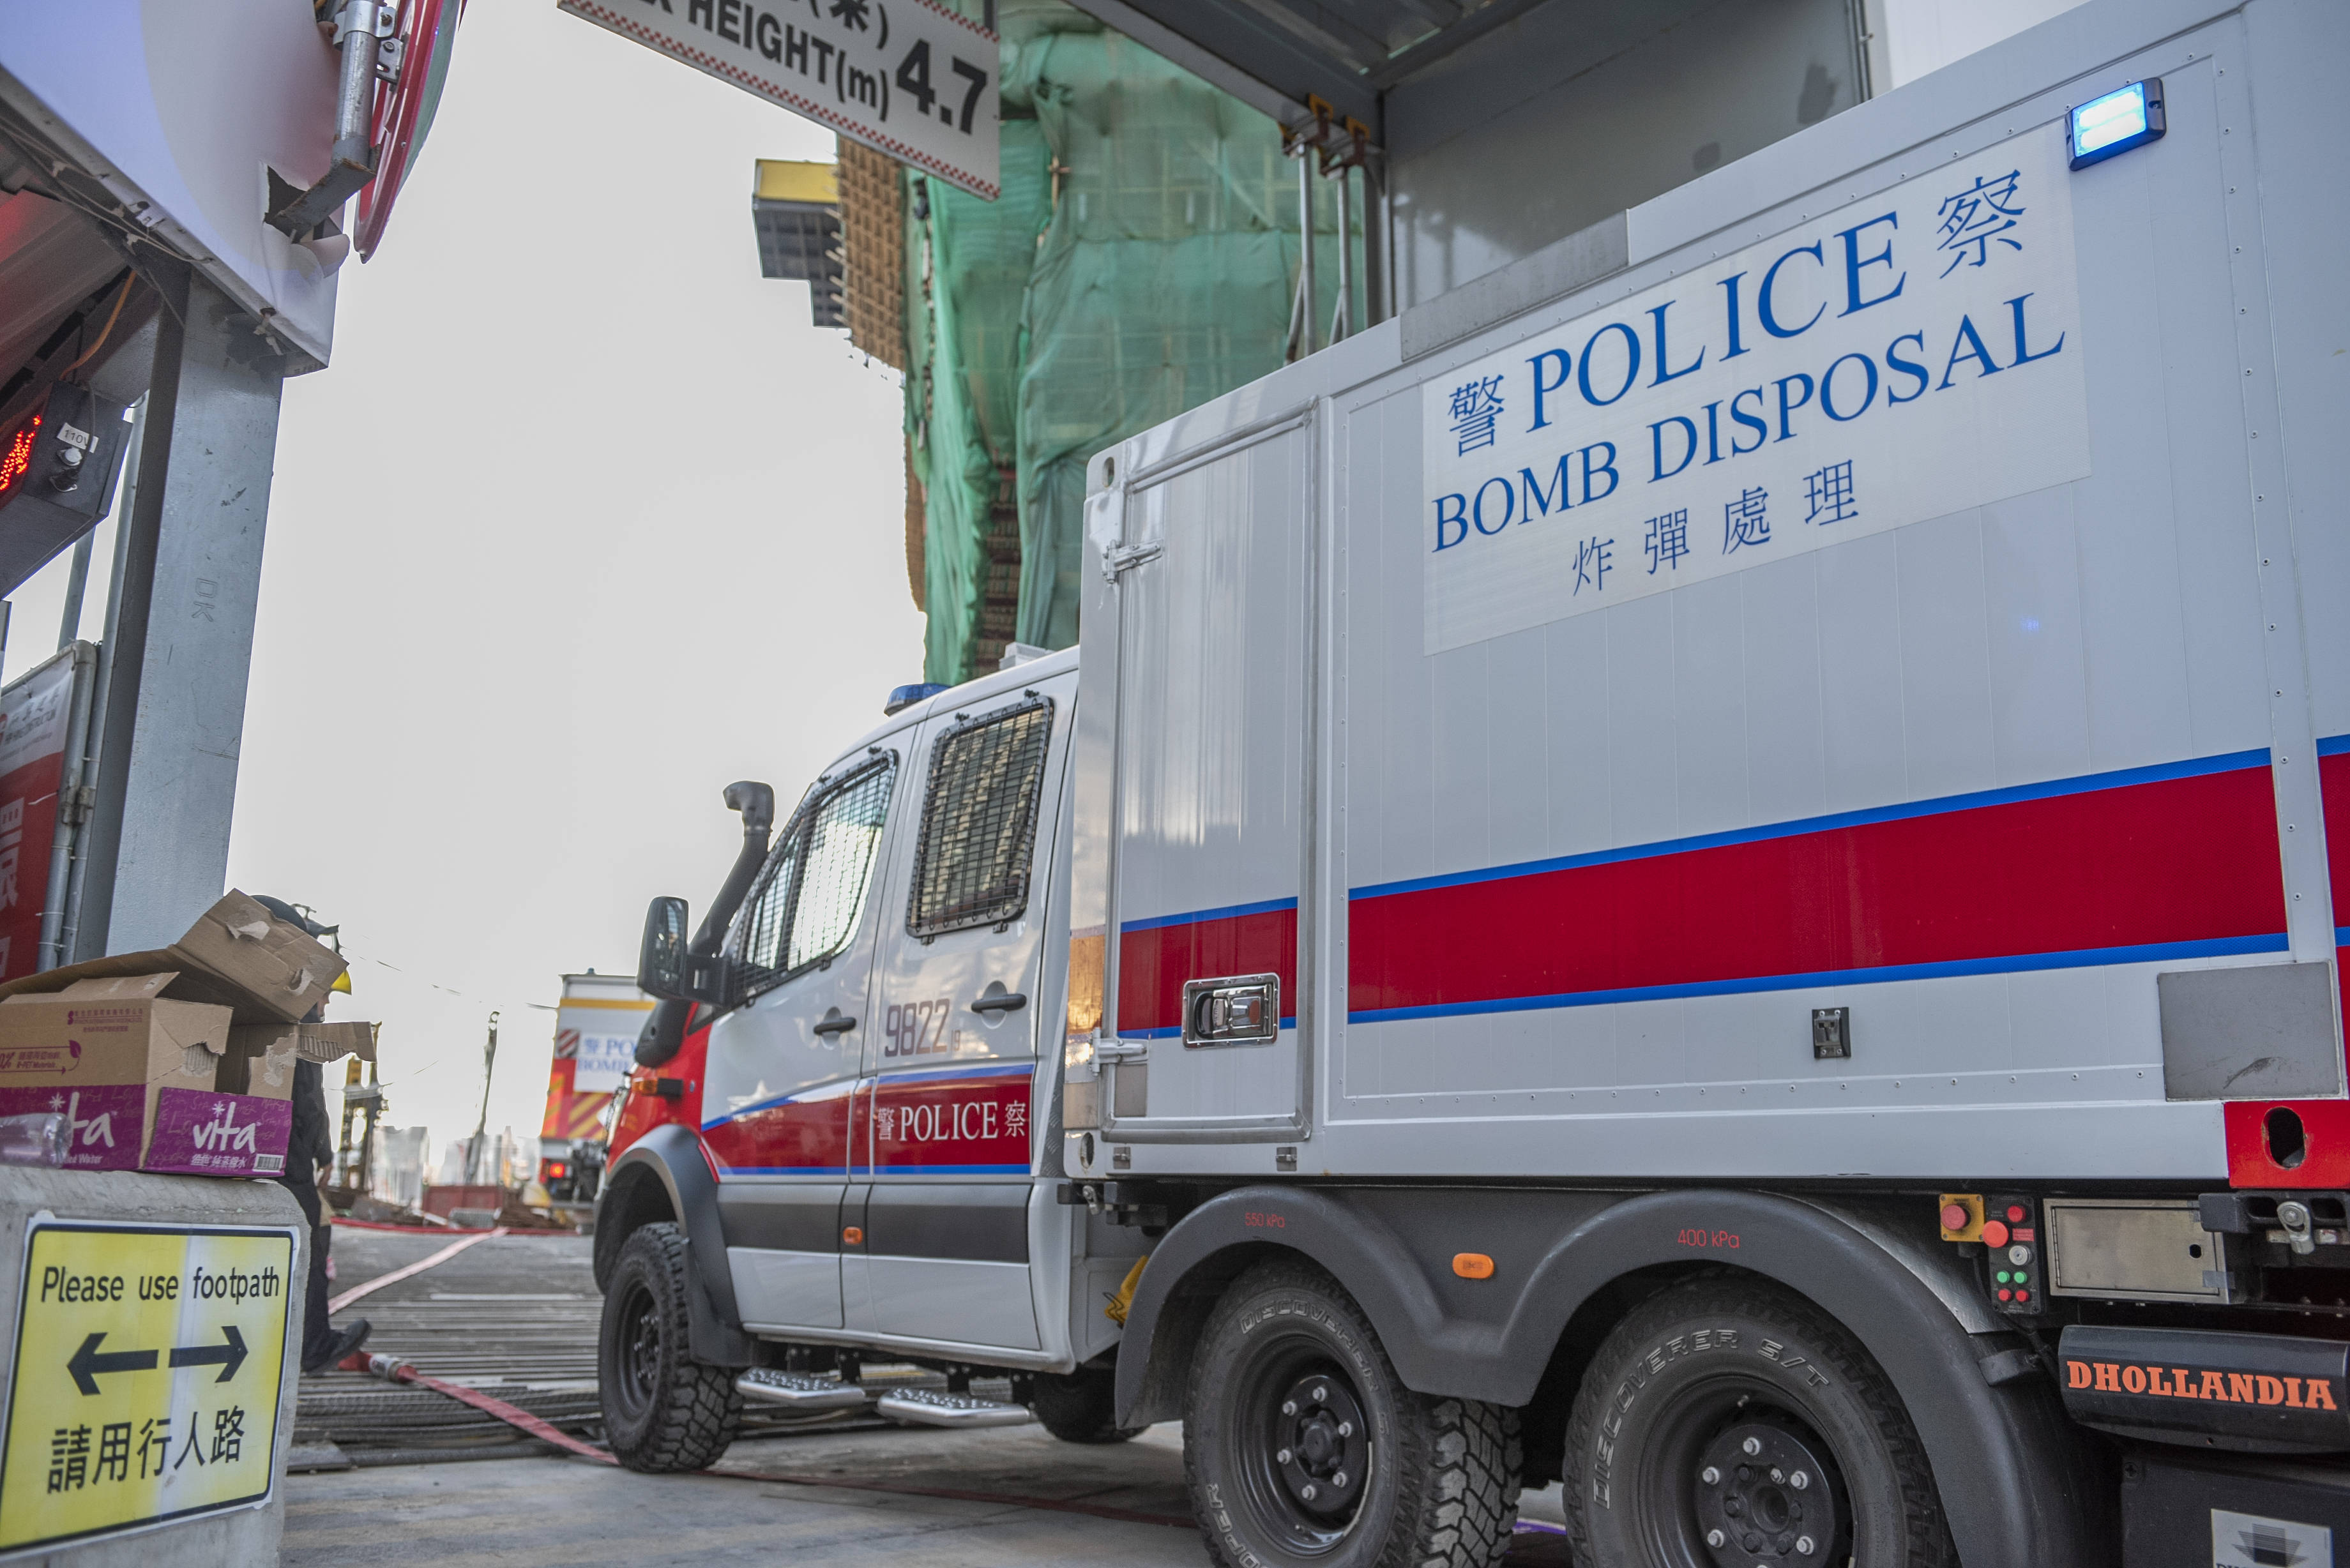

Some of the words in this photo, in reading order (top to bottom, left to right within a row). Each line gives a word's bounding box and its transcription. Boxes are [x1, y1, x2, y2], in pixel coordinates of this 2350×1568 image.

[895, 38, 988, 135] 4.7
[1937, 169, 2025, 279] 察
[1525, 211, 1907, 433] POLICE
[1431, 441, 1619, 553] BOMB
[1646, 292, 2065, 483] DISPOSAL
[1448, 374, 1505, 457] 警
[1572, 459, 1859, 596] 炸彈處理
[605, 1037, 637, 1057] PO
[884, 999, 950, 1057] 9822
[193, 1101, 256, 1154] vita
[877, 1107, 895, 1140] 警
[899, 1101, 998, 1142] POLICE
[1004, 1100, 1026, 1137] 察
[1677, 1229, 1706, 1247] 400
[1711, 1230, 1740, 1249] kPa
[41, 1266, 124, 1303] Please
[139, 1276, 178, 1300] use
[193, 1266, 279, 1305] footpath
[1240, 1299, 1379, 1392] DISCOVERER
[2066, 1361, 2337, 1410] DHOLLANDIA
[47, 1405, 245, 1495] 請用行人路
[1593, 1329, 1738, 1509] DISCOVERER
[1757, 1338, 1830, 1387] S/T
[1206, 1482, 1271, 1568] OPER
